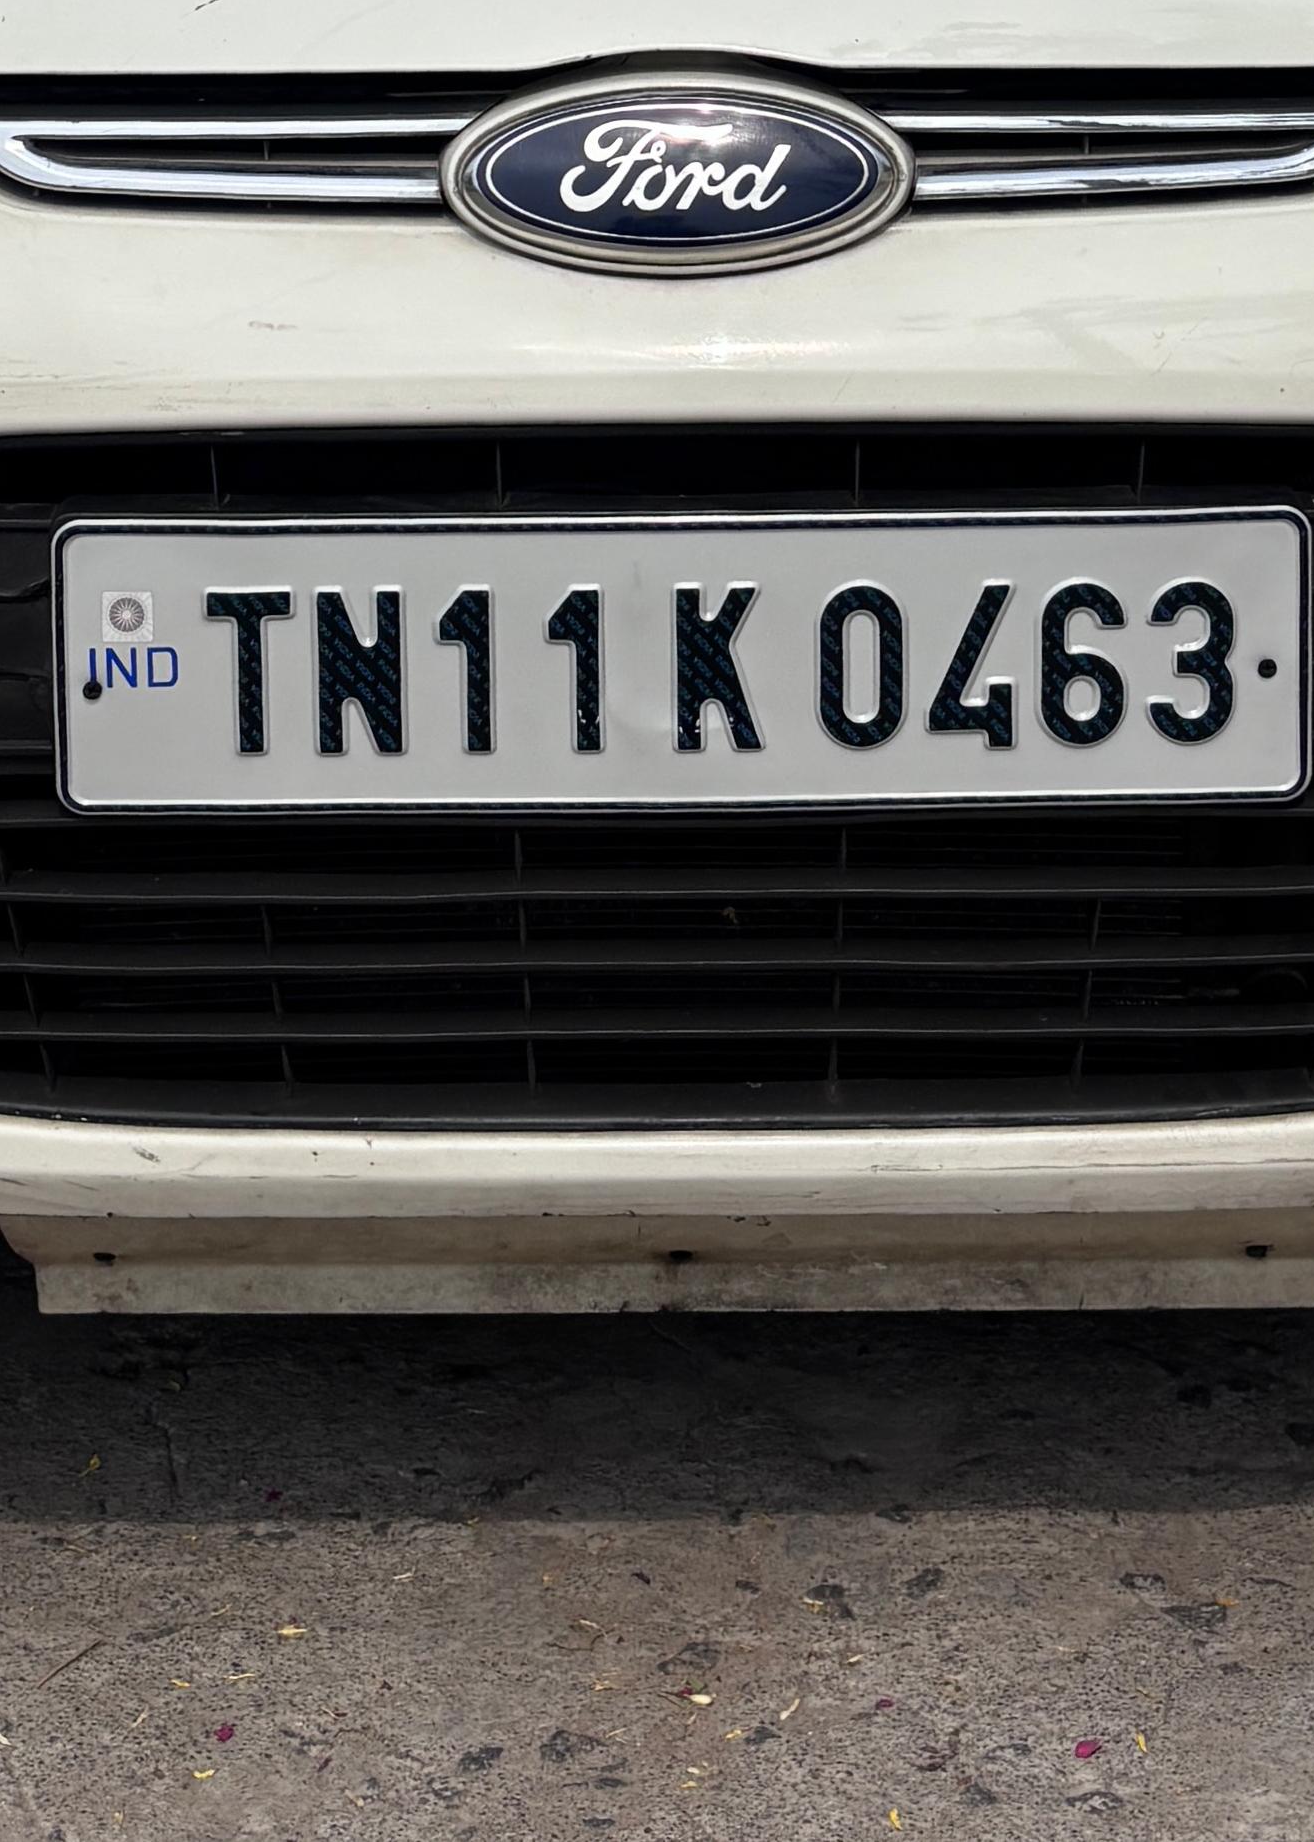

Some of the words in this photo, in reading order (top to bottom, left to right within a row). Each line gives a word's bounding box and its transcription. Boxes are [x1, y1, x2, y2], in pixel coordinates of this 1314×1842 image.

[559, 119, 792, 213] Ford
[88, 646, 179, 688] IND
[675, 586, 763, 751] K
[819, 581, 1234, 747] 0463
